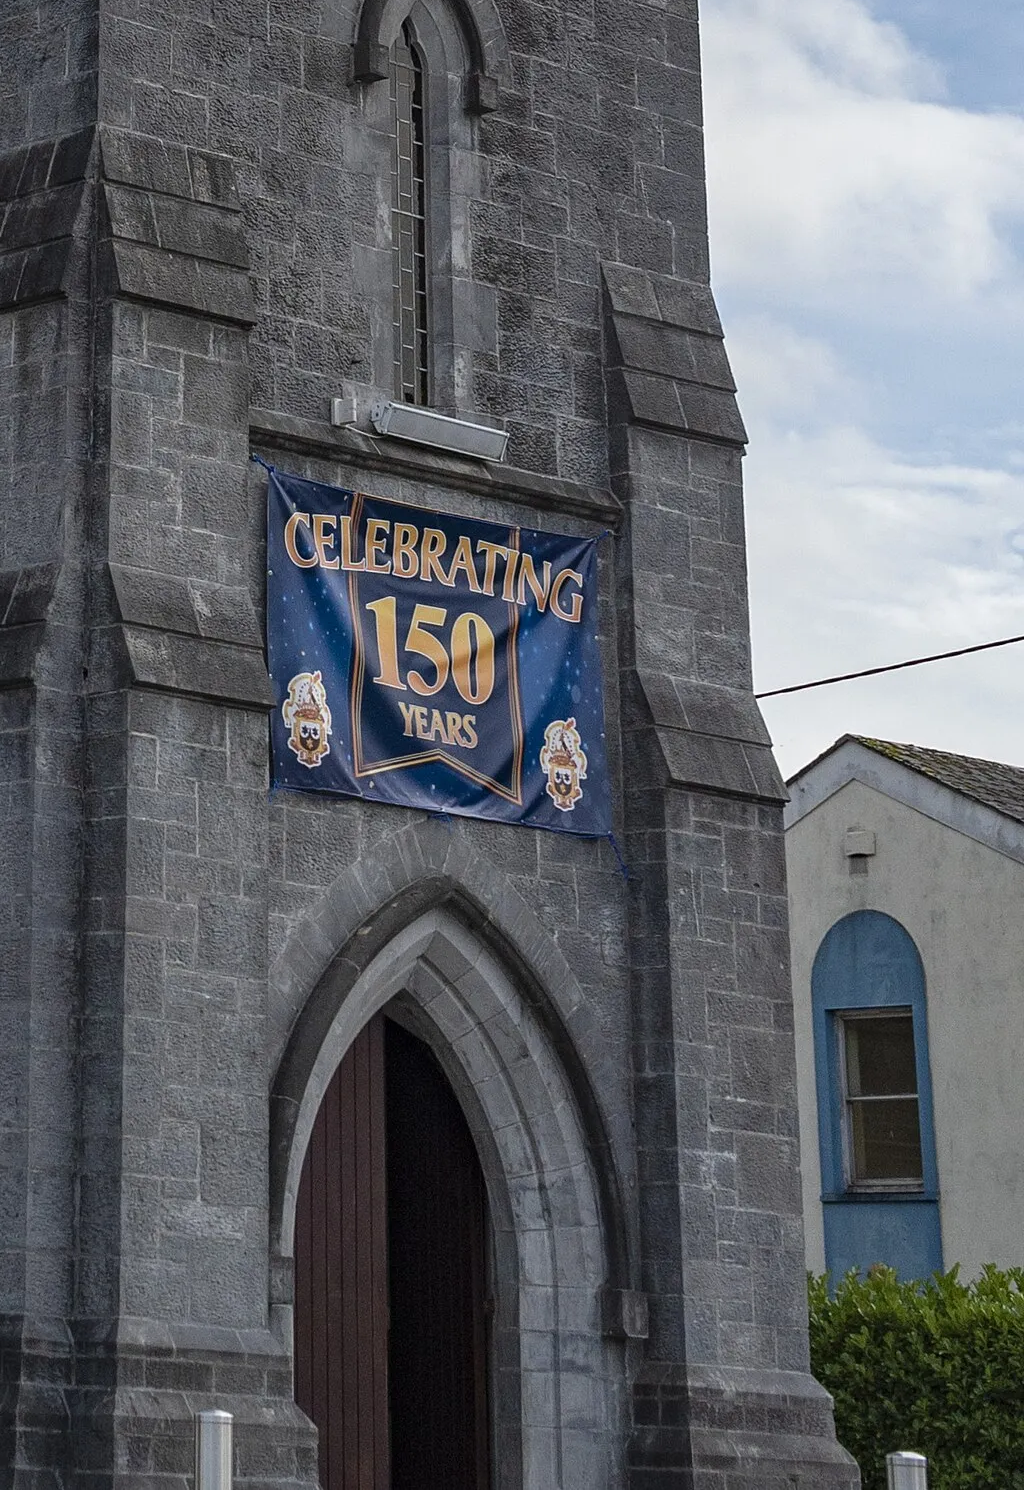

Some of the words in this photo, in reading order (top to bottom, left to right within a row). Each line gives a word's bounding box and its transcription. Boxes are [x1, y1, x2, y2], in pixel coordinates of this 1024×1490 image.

[284, 511, 584, 623] CELEBRATING
[365, 595, 496, 705] 150
[398, 701, 479, 749] YEARS
